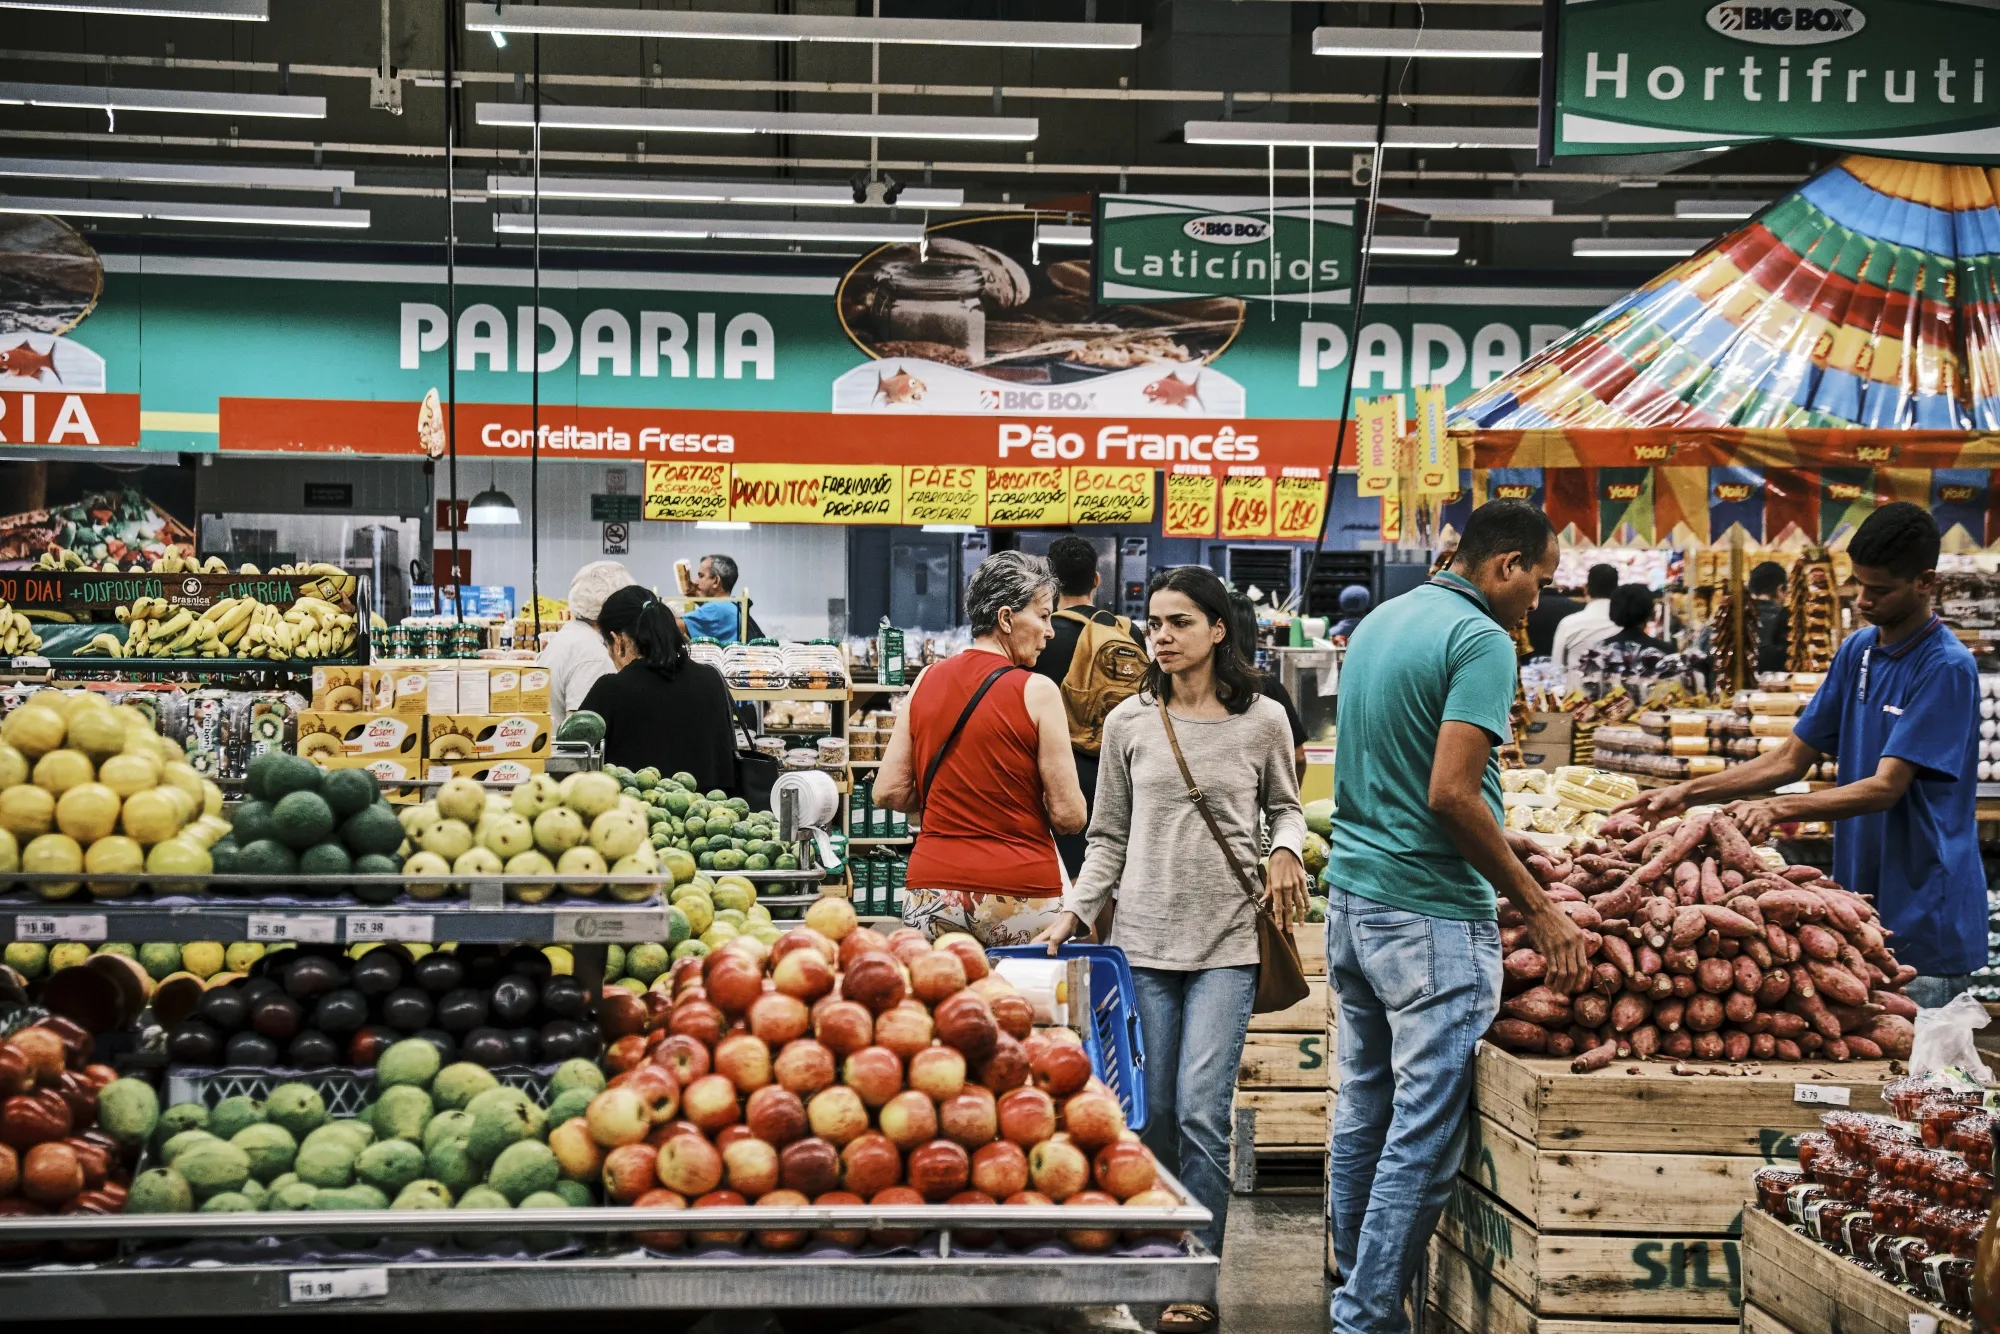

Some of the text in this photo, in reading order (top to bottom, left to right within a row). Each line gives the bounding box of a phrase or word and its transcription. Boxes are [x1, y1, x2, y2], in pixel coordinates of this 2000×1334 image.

[1745, 8, 1856, 32] BIG BOX
[1585, 52, 1984, 104] Hortifruti
[1206, 223, 1267, 237] BIG BOX
[1114, 247, 1340, 281] Laticínios
[400, 302, 775, 380] PADARIA
[1003, 391, 1097, 411] BIG BOX
[481, 423, 735, 454] Confeitaria Fresca
[999, 424, 1260, 461] Pão Francês
[1372, 416, 1384, 467] PIPOCA
[1634, 445, 1667, 460] Yoki
[650, 463, 725, 485] TORTAS
[1173, 464, 1212, 475] OFERTA
[1228, 465, 1266, 477] OFERTA
[821, 473, 892, 496] FABRICAÇÃO
[1074, 469, 1146, 494] BOLOS
[730, 477, 820, 509] PRODUTOS
[1498, 486, 1529, 499] Yoki
[1608, 485, 1640, 499] Yoki
[1717, 484, 1750, 500] Yoki
[25, 579, 62, 603] DIA!
[203, 713, 212, 749] Perboni
[368, 726, 396, 738] Zespri
[500, 726, 527, 738] Zespri
[374, 740, 391, 748] vita
[505, 740, 522, 748] vita
[492, 770, 520, 781] Zespri
[254, 925, 286, 936] 36.98
[353, 922, 384, 934] 26.98
[1801, 1091, 1818, 1099] 5.79
